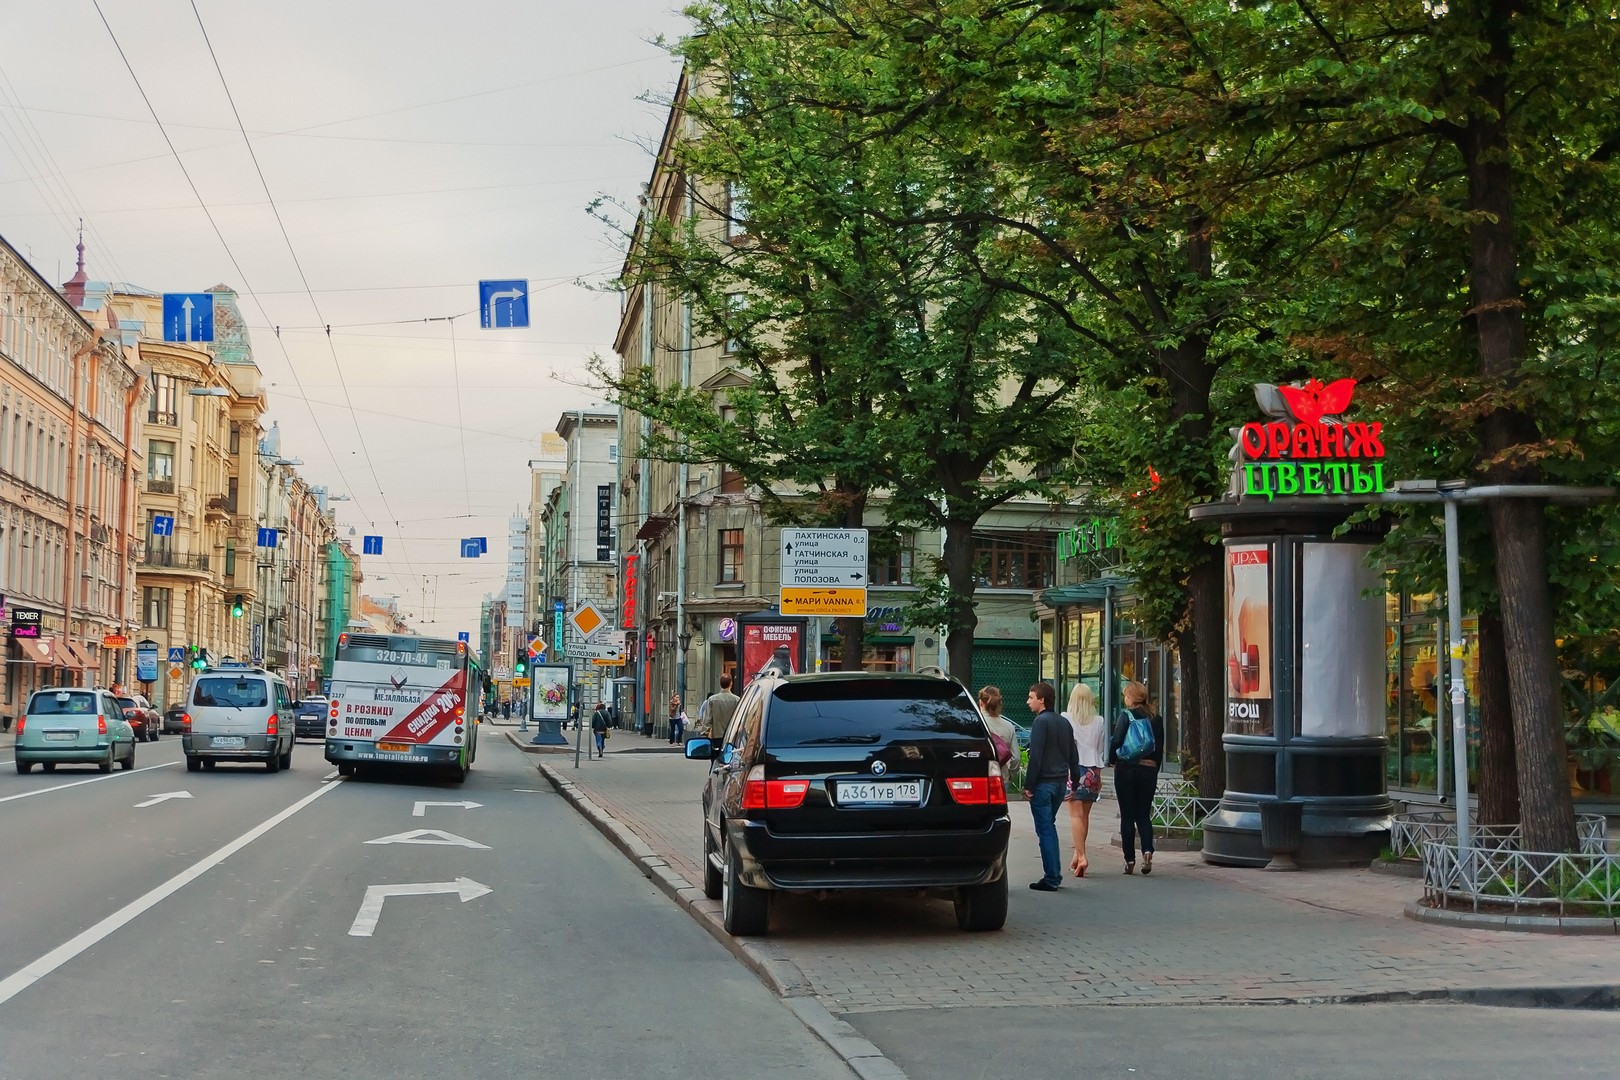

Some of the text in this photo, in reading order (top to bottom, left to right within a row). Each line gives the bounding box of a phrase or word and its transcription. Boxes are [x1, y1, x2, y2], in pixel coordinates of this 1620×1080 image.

[1242, 421, 1385, 459] ОРАНЖ
[1242, 462, 1385, 503] ЦВЕТЫ
[853, 536, 865, 544] 0,2
[794, 550, 849, 558] ГАТЧИНСКАЯ
[795, 597, 821, 605] МАРИ
[15, 611, 39, 620] TEXIER
[763, 633, 792, 641] МЕБЕЛЬ
[376, 650, 429, 664] 320-70-44
[568, 650, 601, 658] ПОЛОЗОВА
[437, 660, 450, 670] 191
[374, 693, 421, 704] МЕТАЛЛОБАЗА
[346, 704, 394, 717] В РОЗНИЦУ
[408, 703, 440, 733] СКИДКА
[436, 688, 461, 714] 20%
[345, 716, 387, 726] ПО ОПТОВЫМ
[344, 727, 372, 737] ЦЕНАМ
